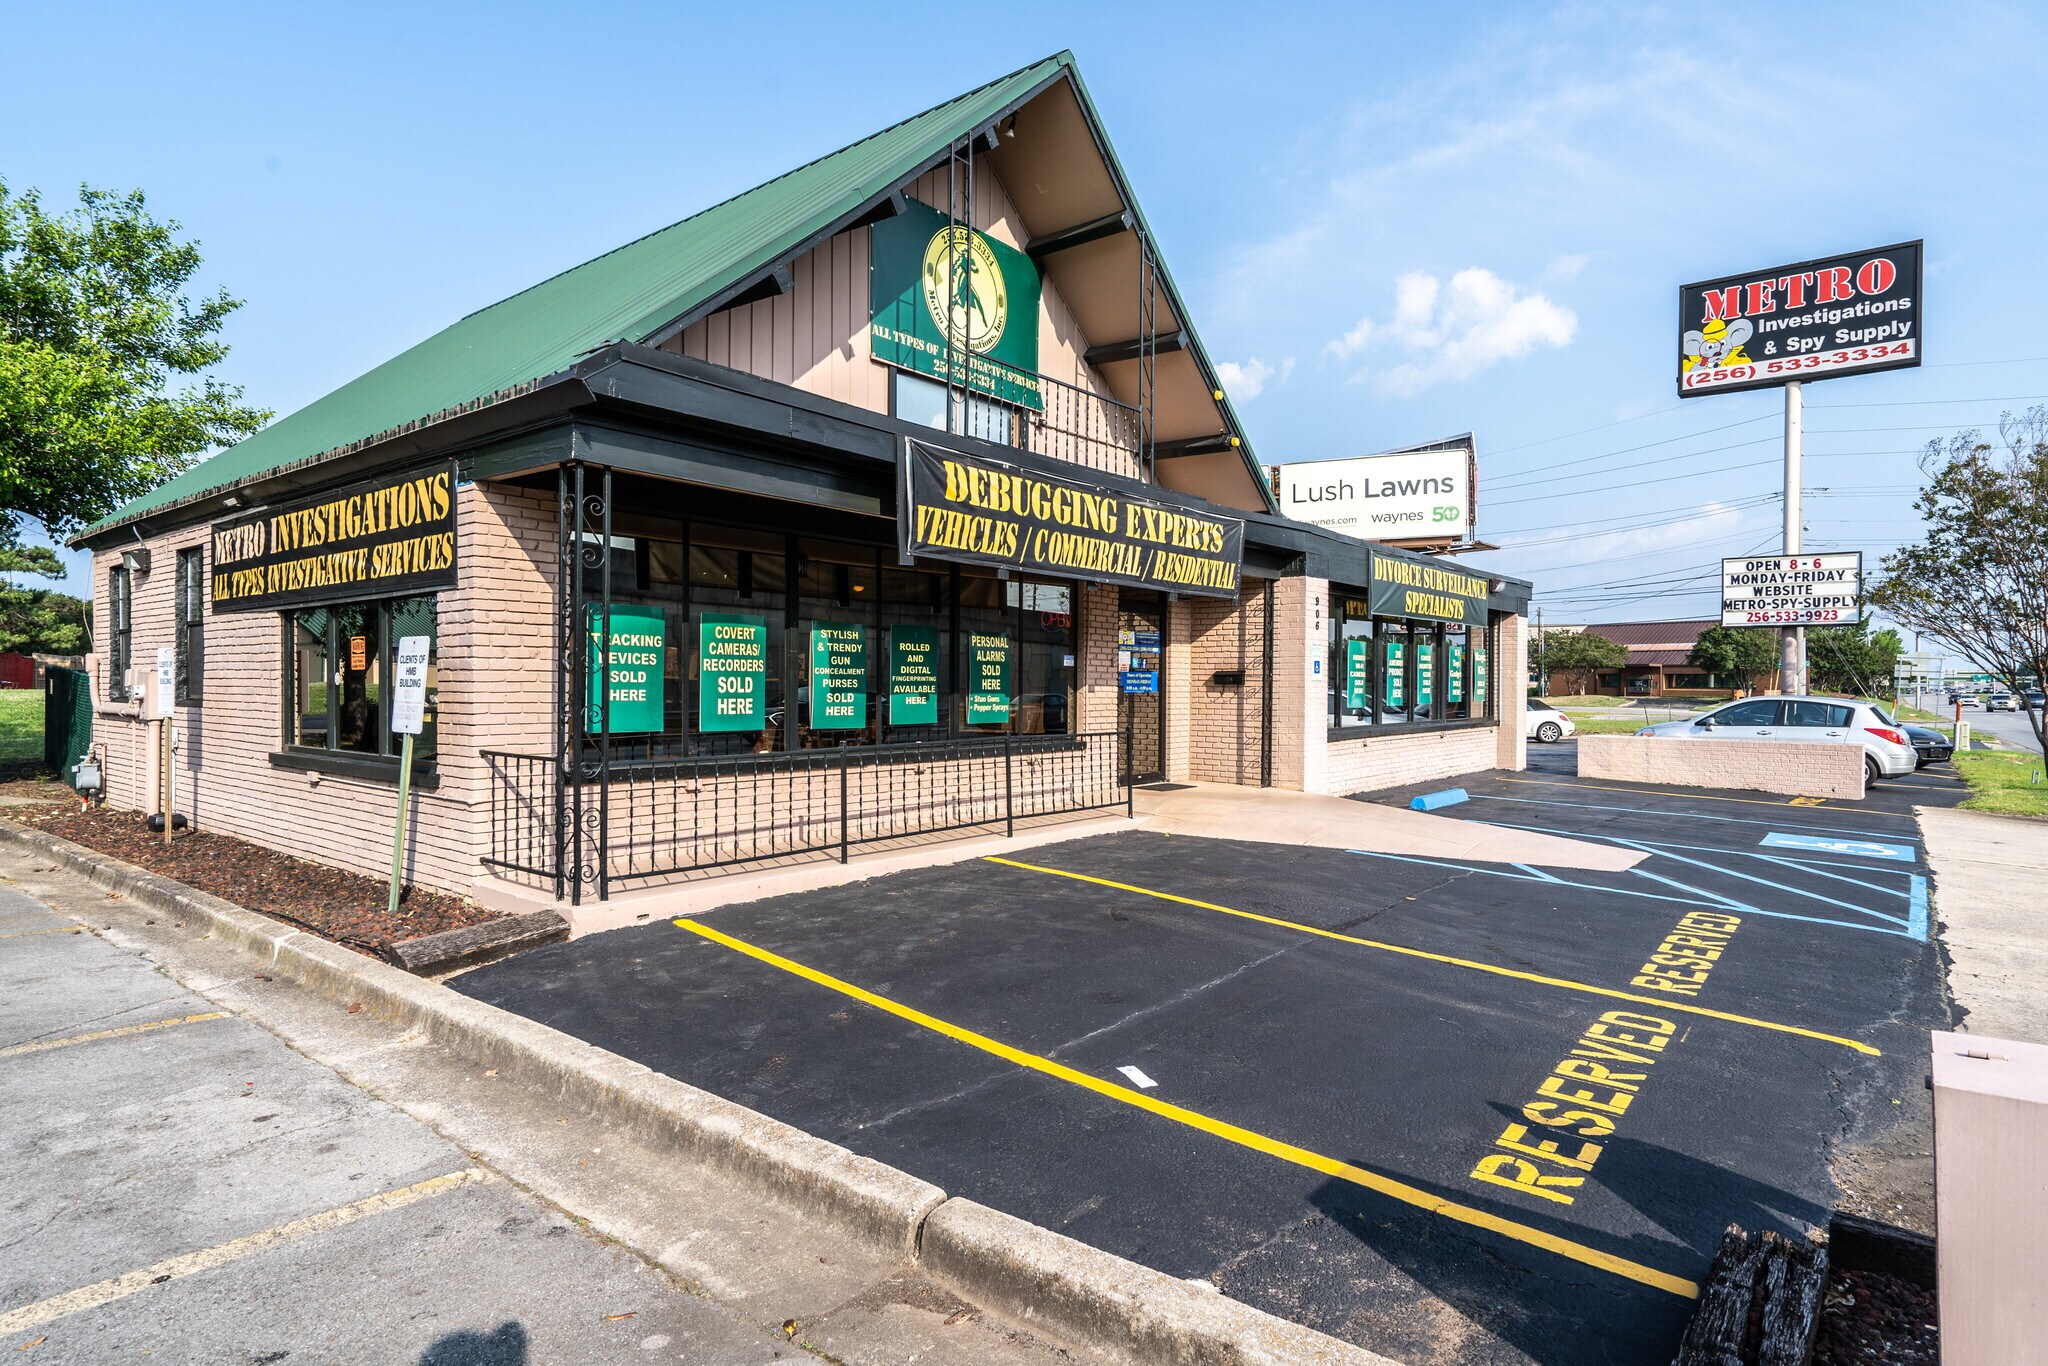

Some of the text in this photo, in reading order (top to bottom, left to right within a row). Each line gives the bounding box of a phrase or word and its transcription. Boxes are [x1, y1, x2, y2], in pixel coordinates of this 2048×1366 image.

[1702, 258, 1896, 323] METRO
[1758, 298, 1911, 333] Investigations
[1764, 320, 1912, 356] & Spy Supply
[872, 324, 891, 340] ALL
[893, 332, 925, 351] TYPES
[926, 342, 939, 355] OF
[943, 348, 1006, 380] IVETIGATIVE
[1686, 342, 1910, 388] (256) 533-3334
[1292, 476, 1454, 503] Lush Lawns
[943, 460, 1224, 553] DEBUGGING EXPERTS
[214, 471, 450, 566] METRO INVESTIGATIONS
[1371, 510, 1424, 524] waynes
[1432, 506, 1460, 522] 50
[917, 504, 1018, 558] VEHICLES
[1034, 528, 1142, 577] COMMERCIAL
[1153, 551, 1236, 590] RESIDENTIAL
[213, 532, 454, 601] ALL TYPES INVESTIGATIVE SERVICES
[1746, 560, 1781, 572] OPEN
[1789, 559, 1798, 570] 8
[1813, 558, 1822, 569] 6
[1374, 557, 1487, 600] DIVORCE SURVEILLANCE
[1731, 570, 1846, 585] MONDAY-FRIDAY
[1753, 585, 1813, 597] WEBSITE
[1405, 590, 1464, 620] SPECIALISTS
[1723, 596, 1858, 610] METRO-SPY-SUPPLY
[1041, 611, 1072, 628] OPEN
[1747, 610, 1838, 623] 256-533-9923
[591, 632, 662, 648] TACKING
[714, 626, 756, 640] COVERT
[820, 629, 859, 640] STYLISH
[709, 642, 761, 656] CAMERAS/
[817, 642, 862, 653] & TRENDY
[899, 643, 930, 651] ROLLED
[971, 635, 1009, 649] PERSONAL
[400, 655, 426, 664] CLIENTS OF
[831, 656, 850, 665] GUN
[907, 655, 924, 663] AND
[976, 650, 1005, 662] ALARMS
[405, 667, 417, 675] HMB
[703, 658, 764, 672] RECORDERS
[814, 667, 865, 675] CONCEALMENT
[900, 666, 931, 674] DIGITAL
[981, 664, 1001, 676] SOLD
[399, 679, 421, 687] BUILDING
[610, 671, 647, 683] SOLD
[822, 679, 858, 688] PURSES
[718, 677, 753, 693] SOLD
[893, 685, 936, 693] AVAILABLE
[981, 679, 1001, 690] HERE
[609, 689, 647, 701] HERE
[826, 692, 854, 702] SOLD
[905, 697, 927, 705] HERE
[717, 698, 753, 715] HERE
[825, 706, 854, 716] HERE
[974, 704, 1009, 712] Pepper Sprays
[1630, 911, 1742, 996] RESERVED
[1470, 1011, 1677, 1205] RESERVED
